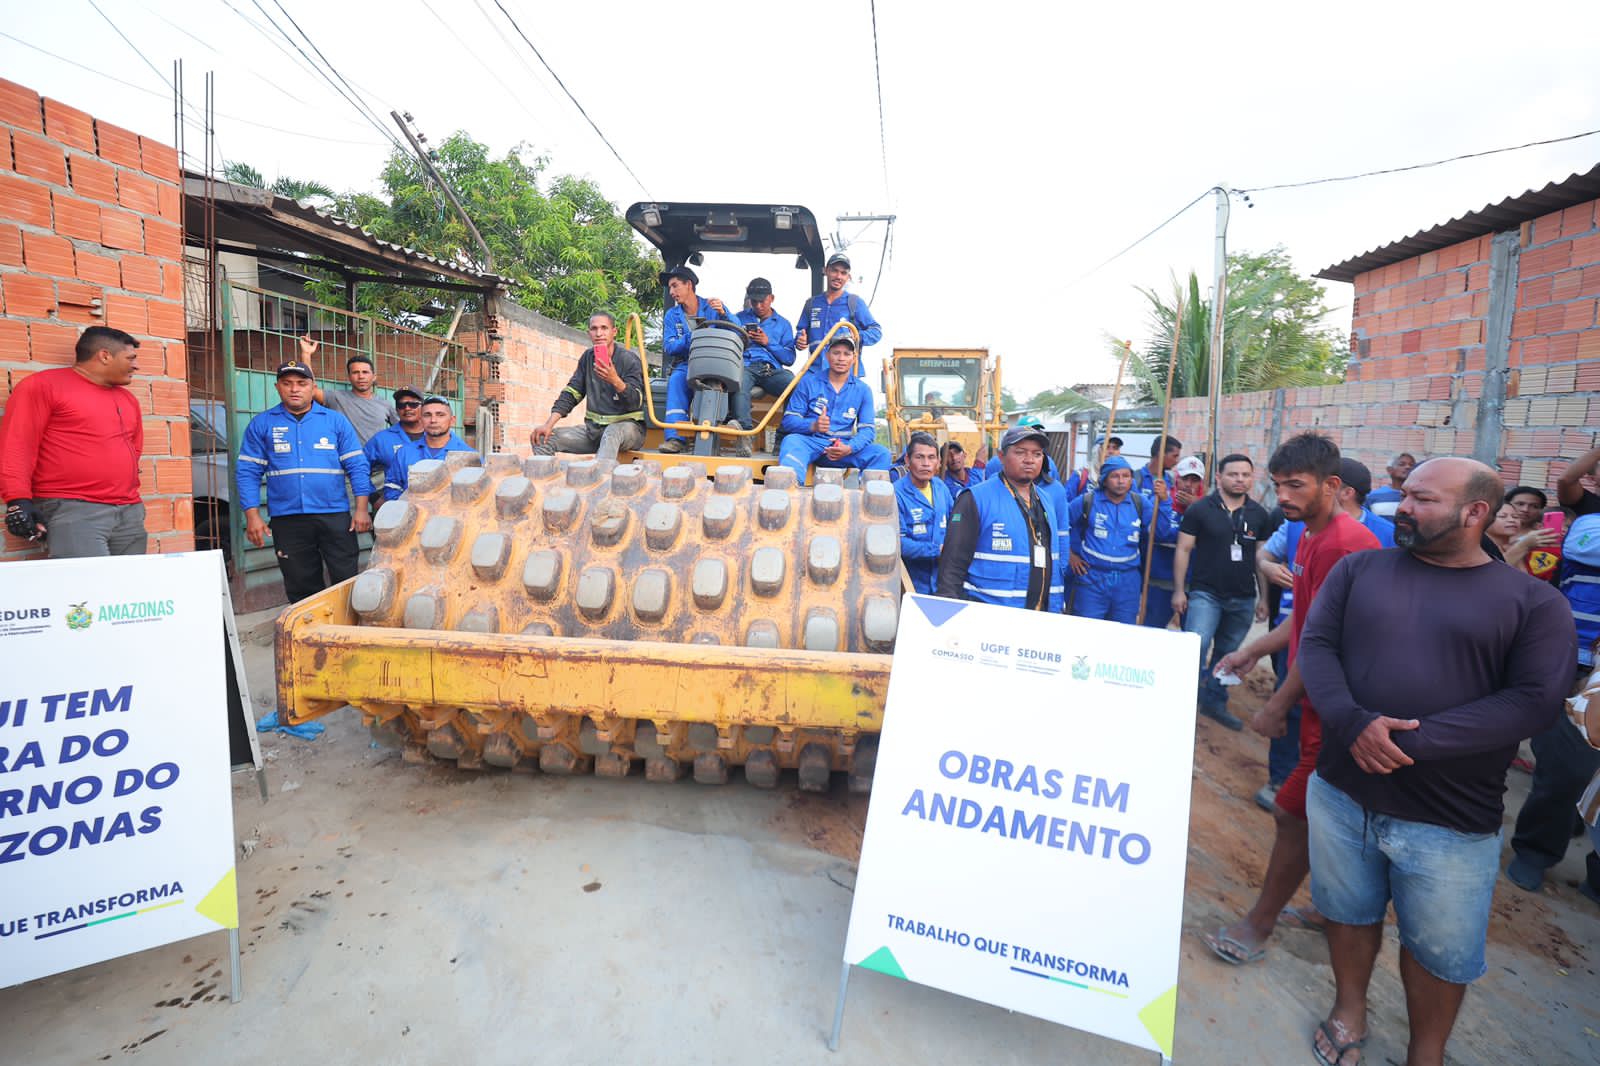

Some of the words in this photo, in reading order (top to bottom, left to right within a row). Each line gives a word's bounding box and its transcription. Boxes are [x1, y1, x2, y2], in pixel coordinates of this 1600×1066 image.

[0, 607, 51, 622] DURB
[98, 600, 175, 622] AMAZONAS
[931, 648, 975, 661] COMPASSO
[980, 642, 1010, 656] UGPE
[1017, 648, 1062, 663] SEDURB
[1094, 662, 1155, 687] AMAZONAS
[40, 684, 133, 723] TEM
[58, 728, 130, 764] DO
[113, 761, 181, 798] DO
[938, 749, 1064, 799] OBRAS
[1071, 774, 1130, 813] EM
[0, 805, 163, 864] ZONAS
[901, 788, 1152, 866] ANDAMENTO
[34, 880, 184, 930] TRANSFORMA
[887, 913, 971, 948] TRABALHO
[974, 936, 1009, 958] QUE
[1012, 945, 1130, 988] TRANSFORMA
